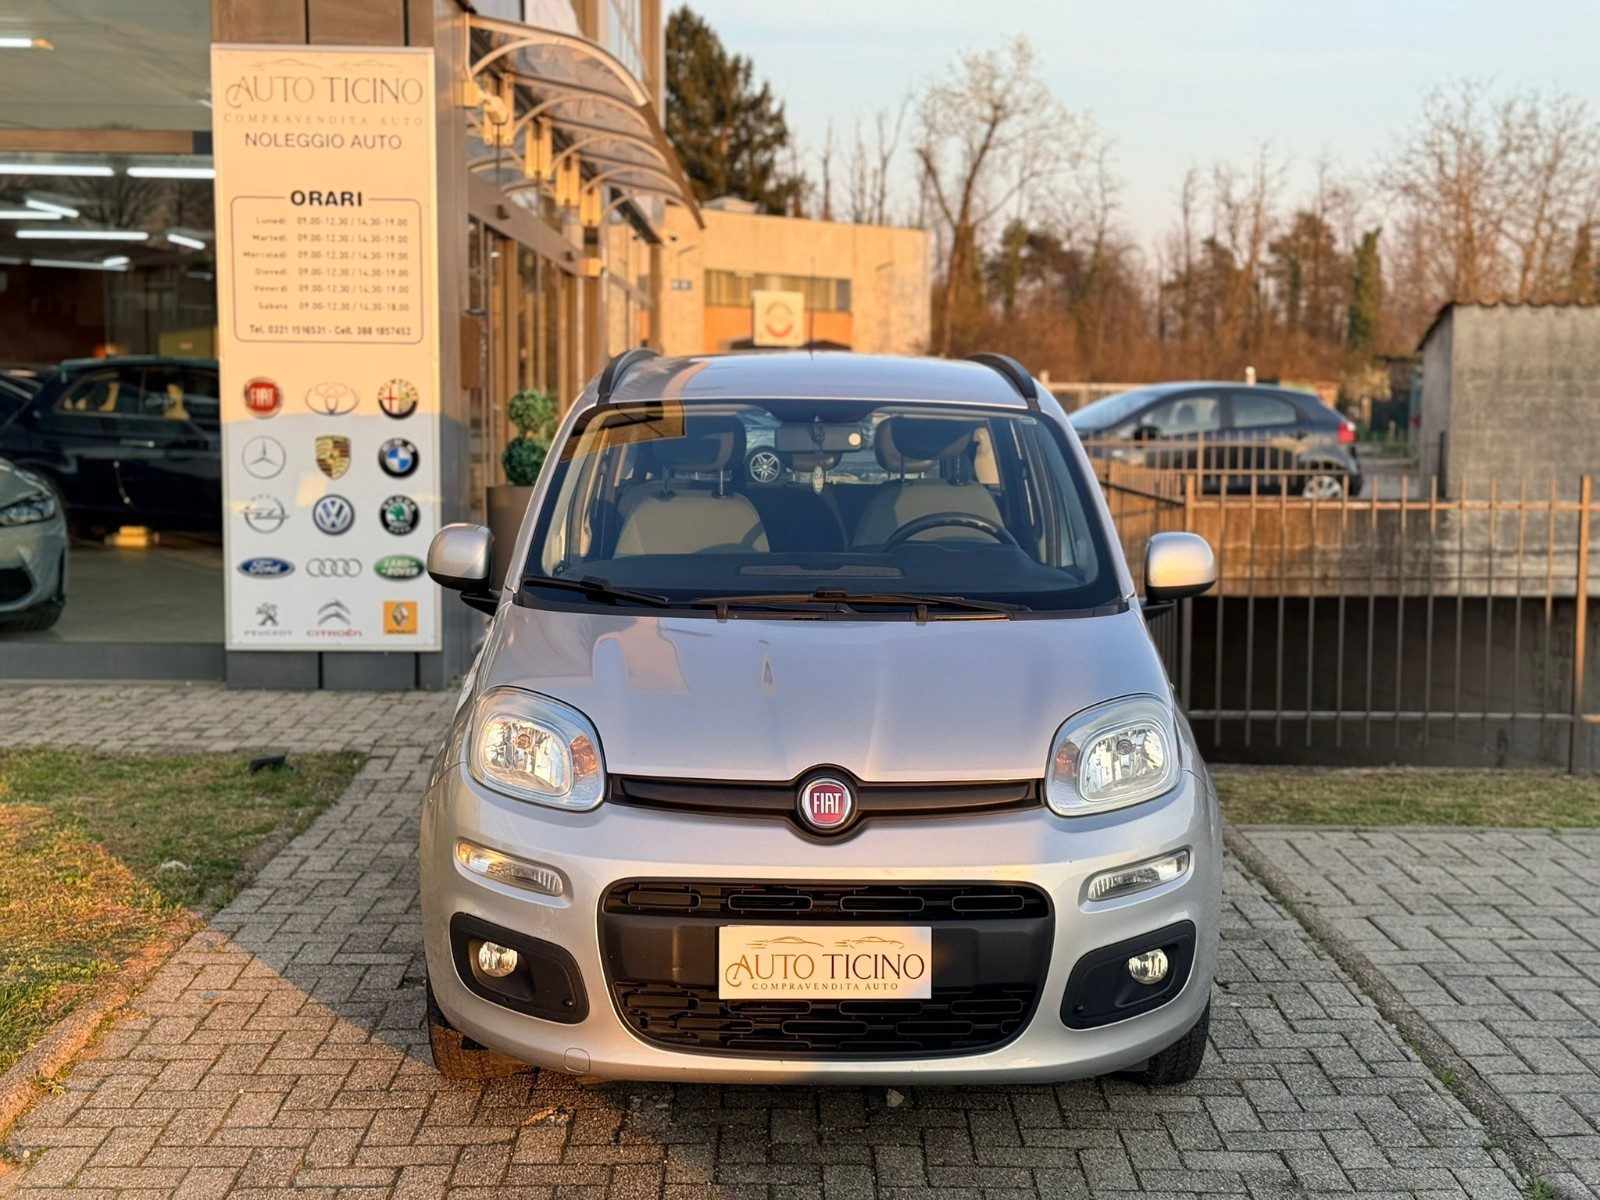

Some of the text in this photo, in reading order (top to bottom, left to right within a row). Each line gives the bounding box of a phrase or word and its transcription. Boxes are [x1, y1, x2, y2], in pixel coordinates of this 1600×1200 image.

[225, 75, 423, 108] AUTO TICINO
[223, 113, 423, 127] COMPRAVENDITA AUTO
[244, 132, 403, 150] NOLEGGIO AUTO
[290, 189, 363, 207] ORARI
[250, 387, 274, 407] FIAT
[813, 792, 841, 814] FIAT
[725, 953, 925, 987] AUTO TICINO
[751, 982, 898, 991] COMPRAVENDITA AUTO
